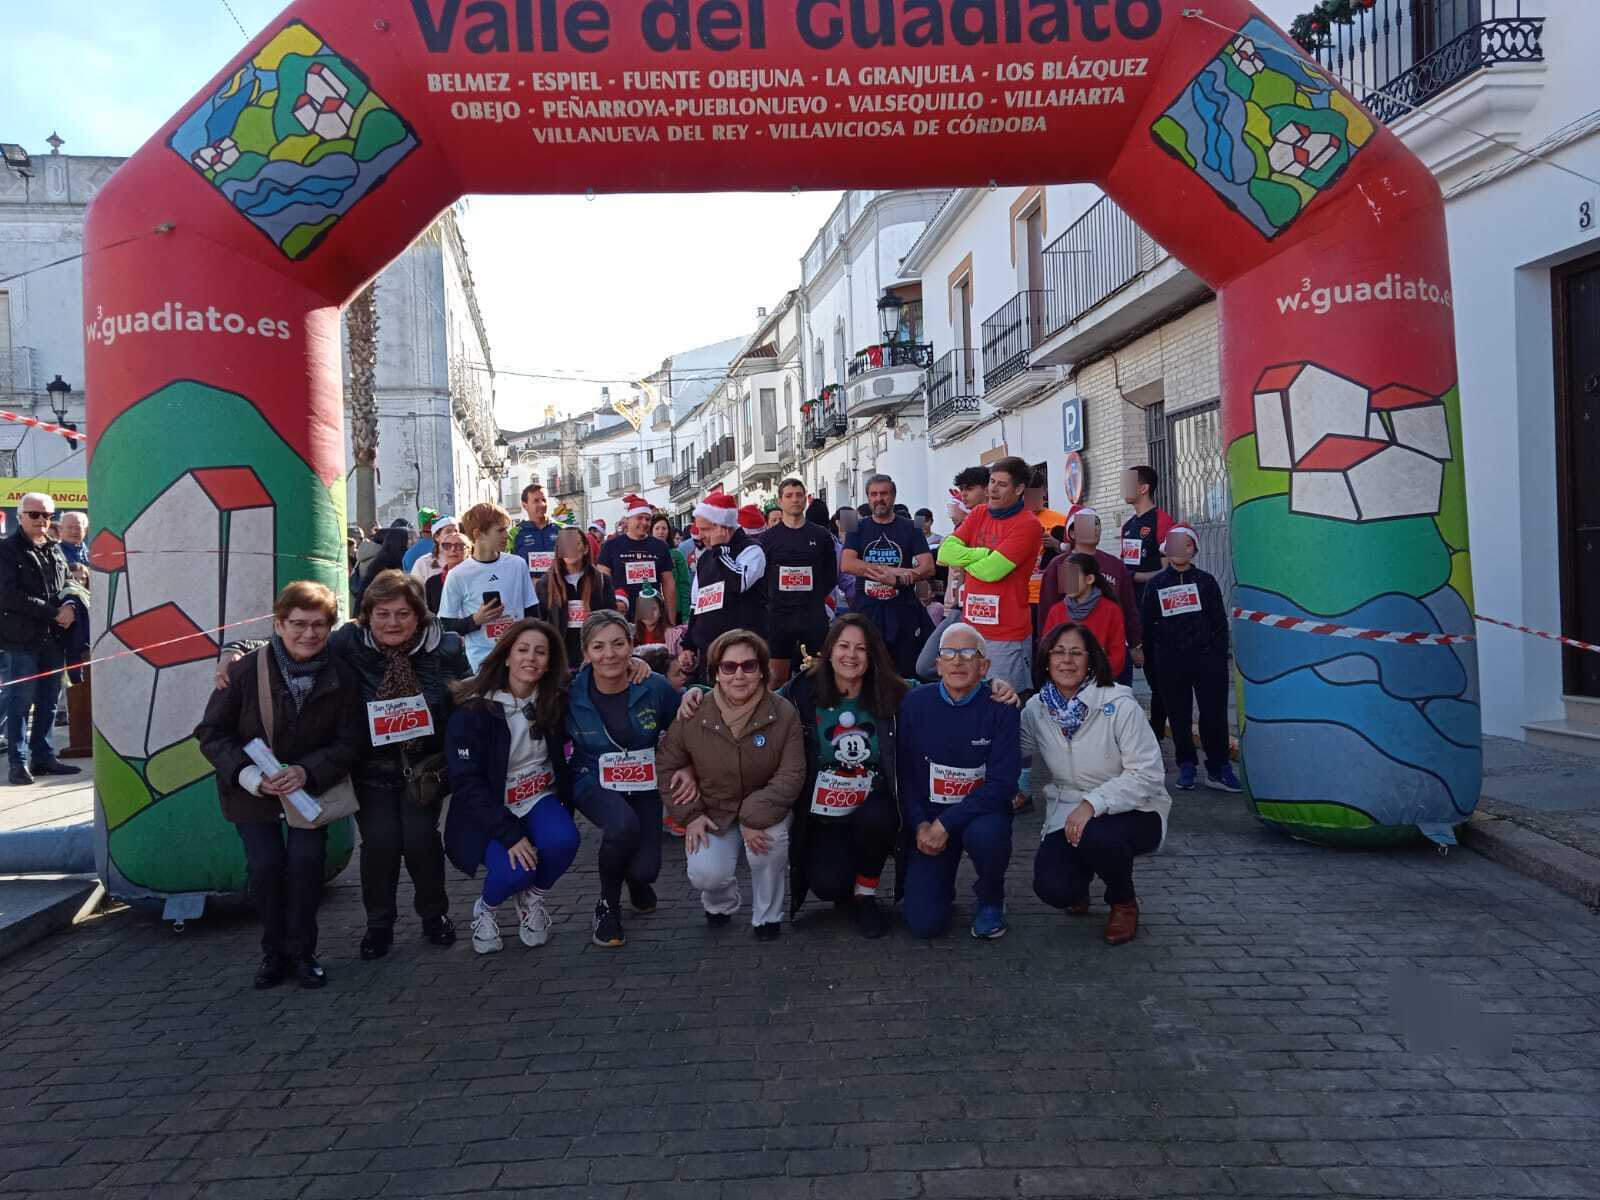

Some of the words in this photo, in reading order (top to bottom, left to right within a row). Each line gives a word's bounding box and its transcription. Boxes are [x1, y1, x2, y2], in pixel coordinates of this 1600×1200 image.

[410, 0, 610, 54] Valle
[641, 0, 766, 51] del
[795, 0, 1162, 50] Guadiato
[427, 72, 511, 92] BELMEZ
[532, 71, 602, 91] ESPIEL
[623, 70, 701, 90] FUENTE
[708, 67, 804, 92] OBEJUNA
[826, 68, 850, 86] LA
[858, 64, 975, 88] GRANJUELA
[996, 62, 1034, 82] LOS
[1041, 56, 1149, 80] BLÁZQUEZ
[450, 101, 521, 122] OBEJO
[543, 96, 828, 119] PEÑARROYA-PUEBLONUEVO
[848, 92, 984, 113] VALSEQUILLO
[1004, 86, 1125, 109] VILLAHARTA
[532, 125, 660, 144] VILLANUEVA
[668, 125, 704, 142] DEL
[712, 124, 749, 141] REY
[769, 121, 906, 140] VILLAVICIOSA
[913, 119, 938, 136] DE
[946, 113, 1047, 135] CÓRDOBA
[1579, 201, 1591, 228] 3
[1065, 405, 1076, 447] P
[868, 549, 897, 557] PINK
[384, 711, 418, 736] 775
[612, 766, 647, 782] 823
[515, 775, 546, 801] 848
[824, 791, 858, 806] 690
